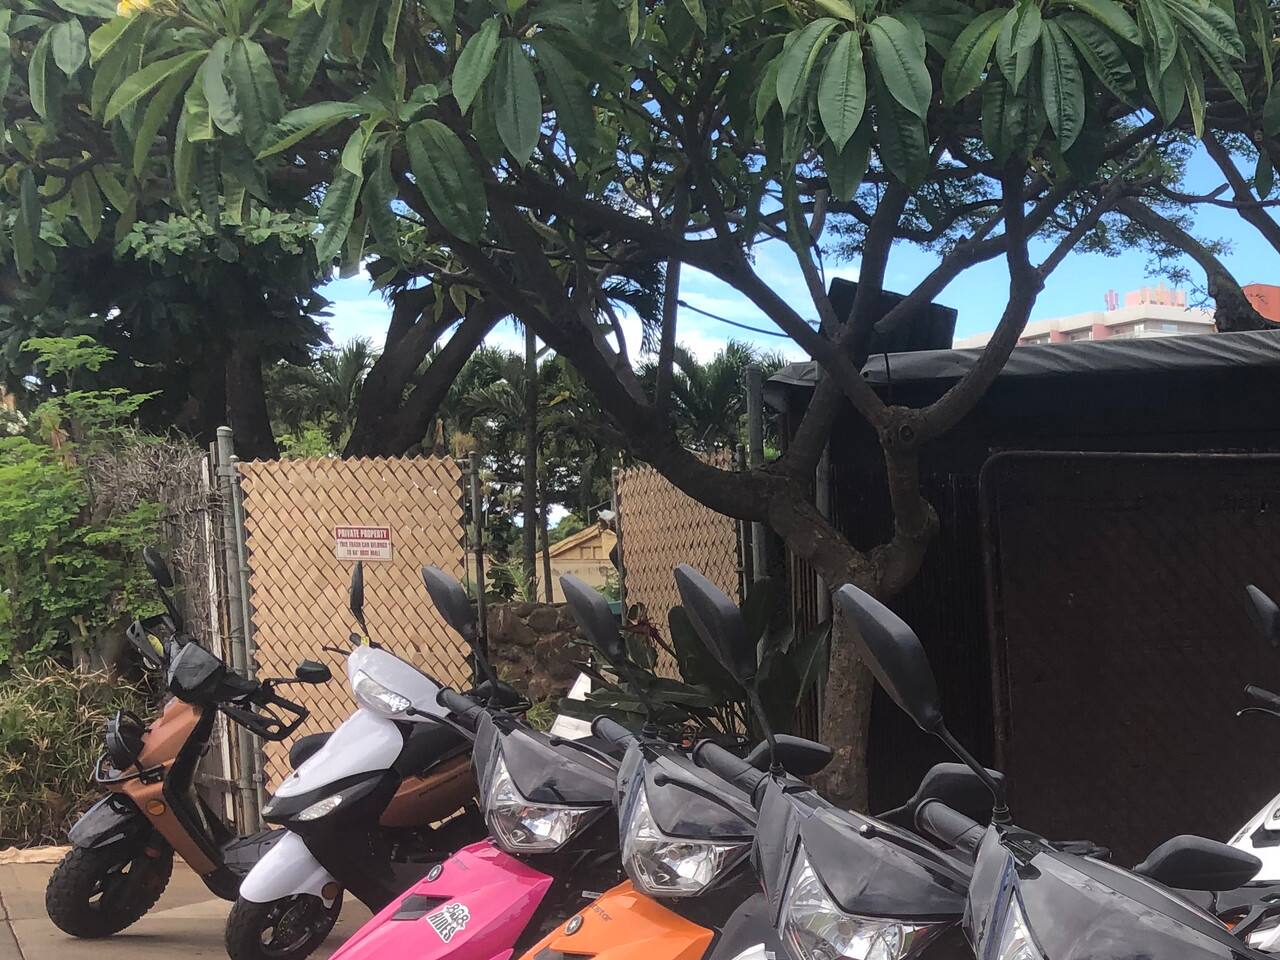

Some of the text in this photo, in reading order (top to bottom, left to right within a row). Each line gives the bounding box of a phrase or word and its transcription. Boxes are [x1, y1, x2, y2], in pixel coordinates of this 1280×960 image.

[338, 529, 387, 539] PRIVATE PROPERTY
[427, 911, 457, 942] RIDES
